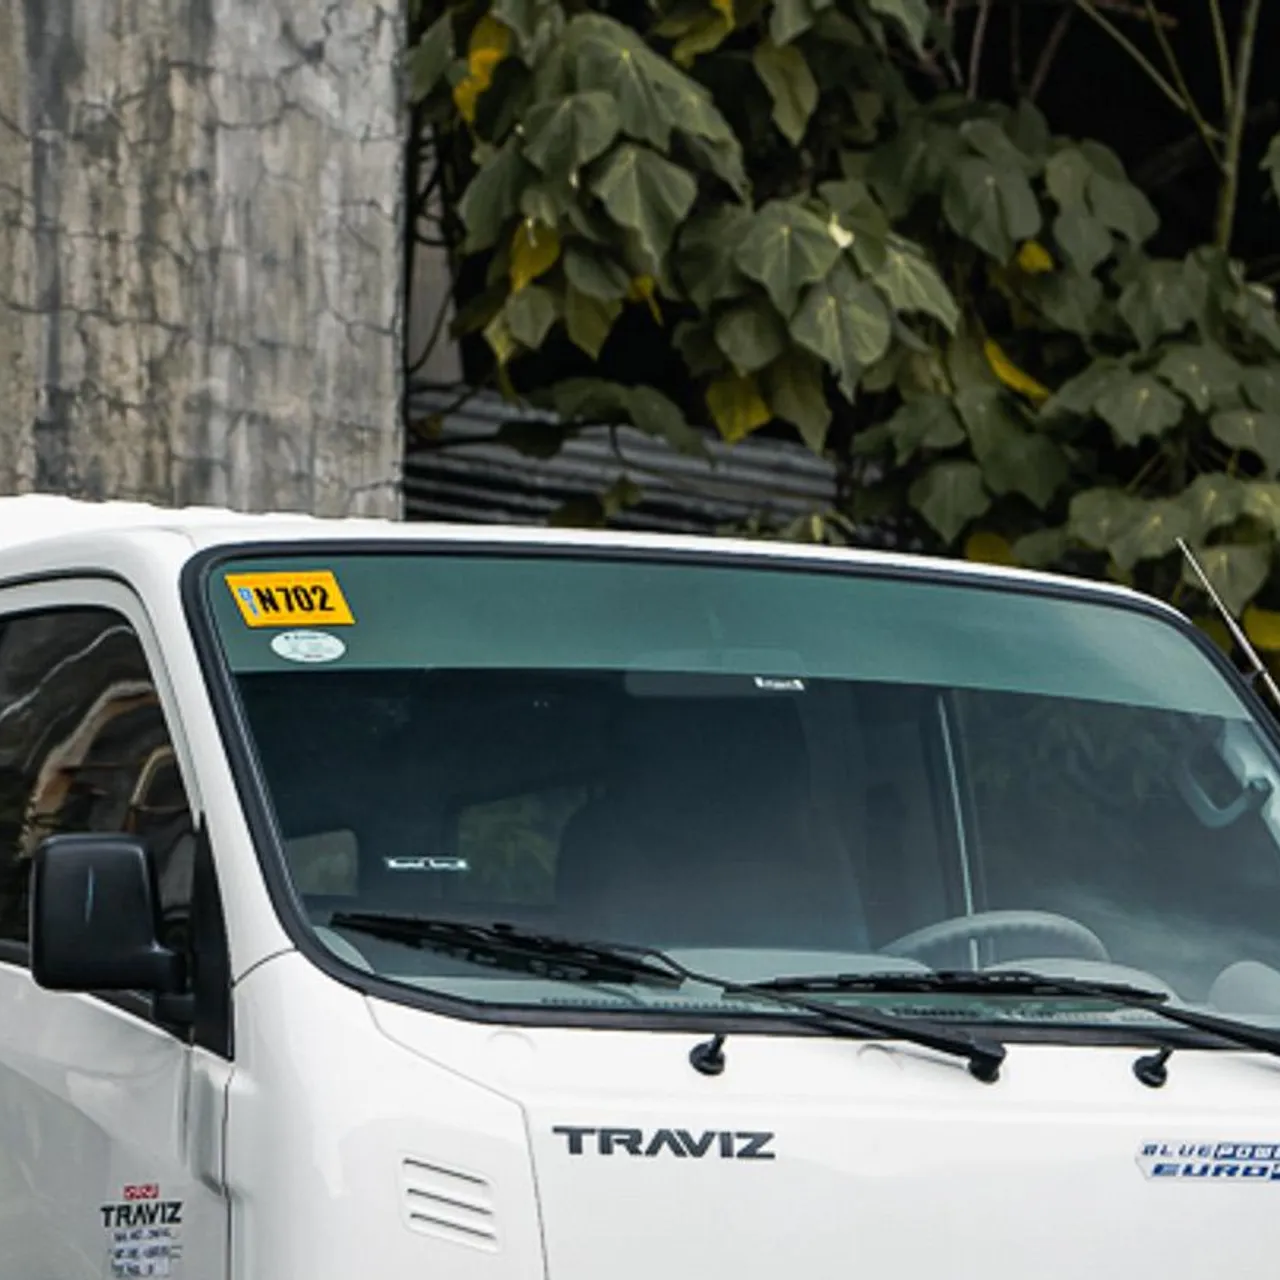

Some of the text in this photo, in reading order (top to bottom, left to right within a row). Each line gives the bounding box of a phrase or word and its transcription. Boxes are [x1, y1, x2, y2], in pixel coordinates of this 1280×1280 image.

[254, 585, 335, 613] N702
[552, 1126, 776, 1160] TRAVIZ
[100, 1202, 183, 1227] TRAVIZ
